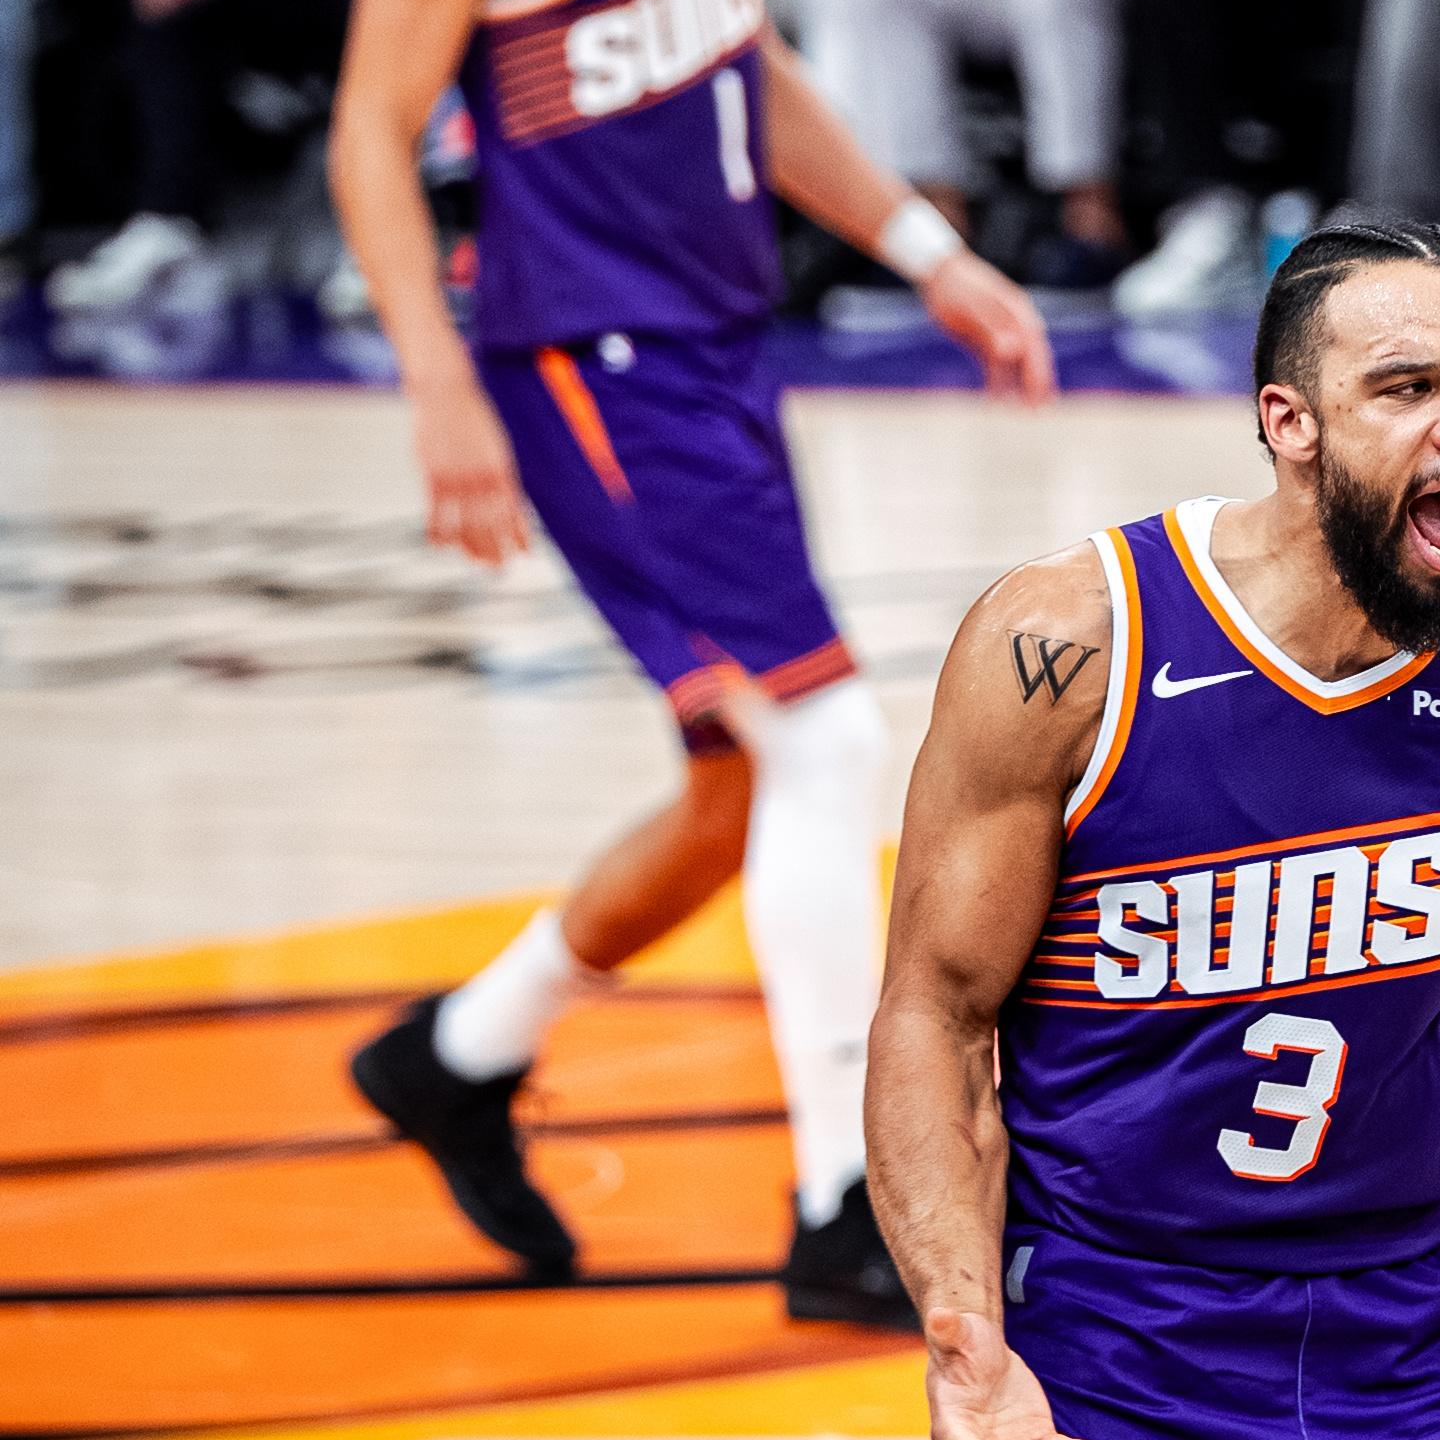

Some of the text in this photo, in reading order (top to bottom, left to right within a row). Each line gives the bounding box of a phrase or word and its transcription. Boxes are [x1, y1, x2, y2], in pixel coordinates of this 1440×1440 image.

[713, 66, 756, 202] 1
[1007, 628, 1101, 707] W
[1216, 1012, 1348, 1182] 3
